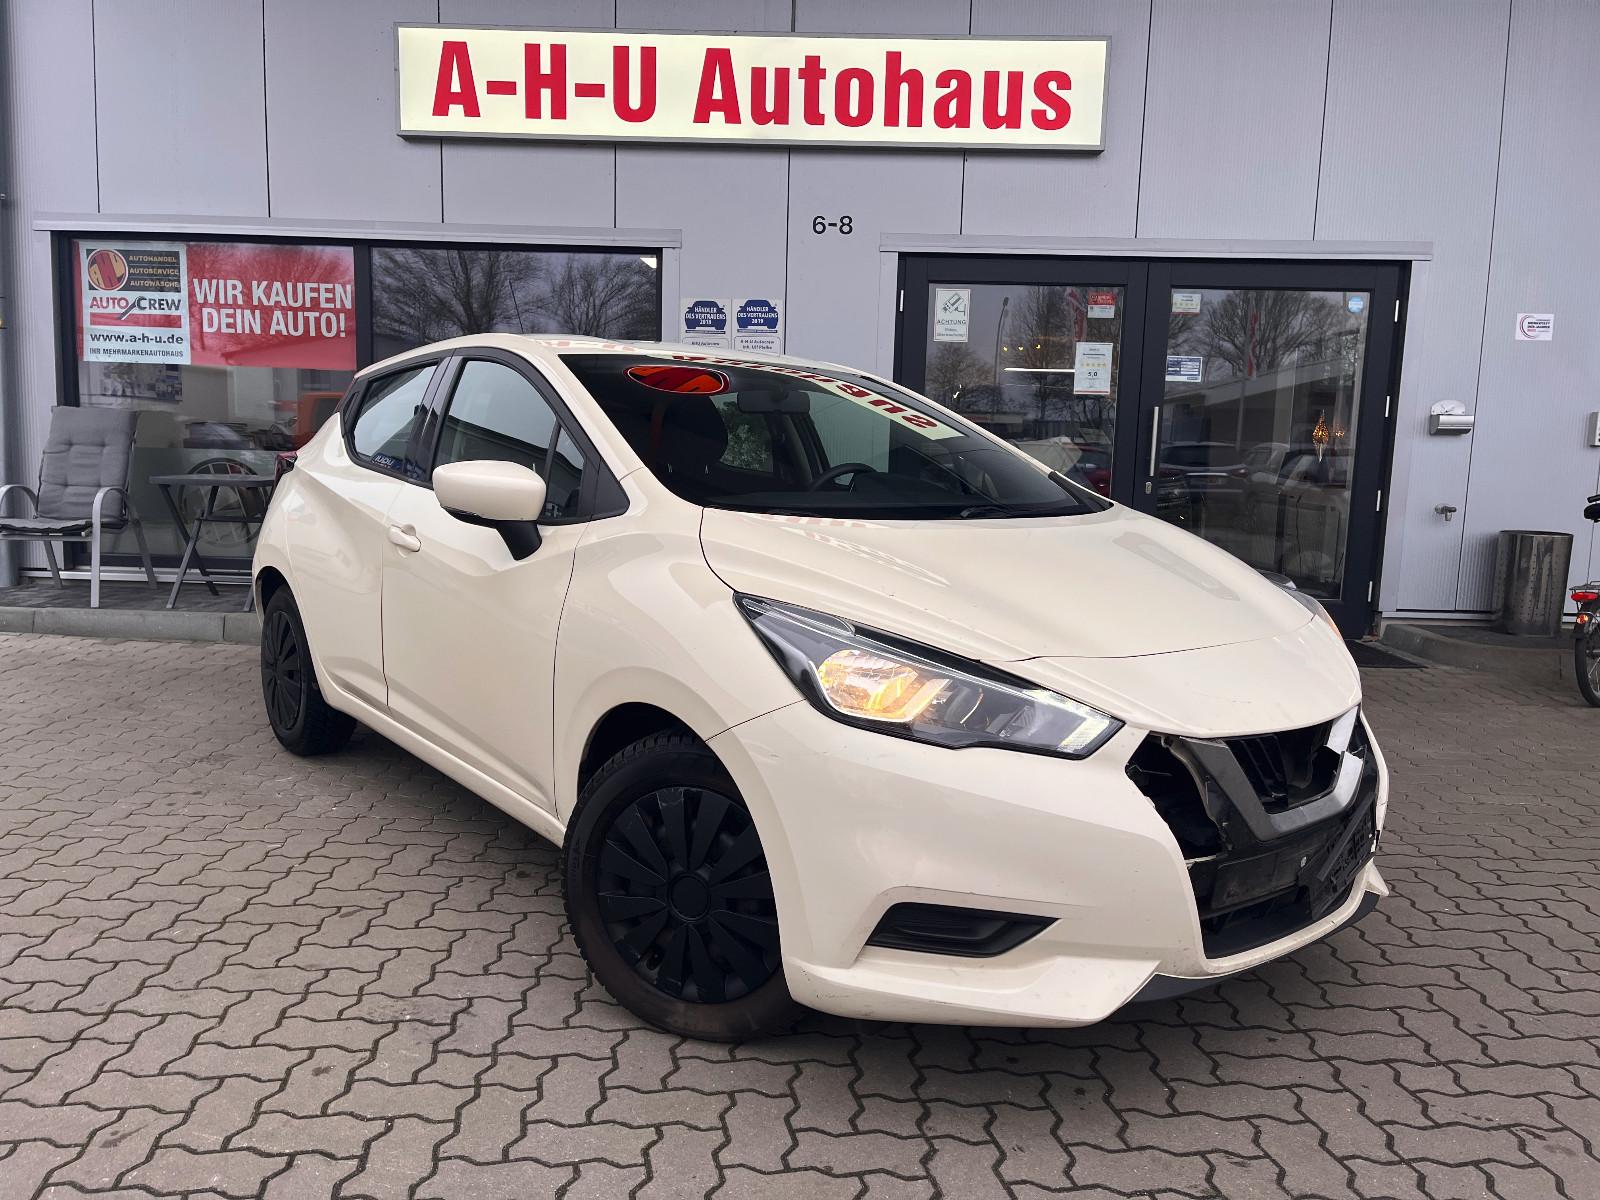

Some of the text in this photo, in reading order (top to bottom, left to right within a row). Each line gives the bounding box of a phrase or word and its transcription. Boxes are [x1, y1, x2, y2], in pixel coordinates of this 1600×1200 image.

[431, 40, 1072, 131] A-H-U Autohaus
[812, 214, 854, 236] 6-8
[129, 255, 177, 263] AUTOHANDEL
[89, 296, 182, 311] AUTO CREW
[192, 278, 353, 310] WIR KAUFEN
[201, 307, 346, 338] DEIN AUTO!
[90, 332, 184, 345] www.a-h-u.de
